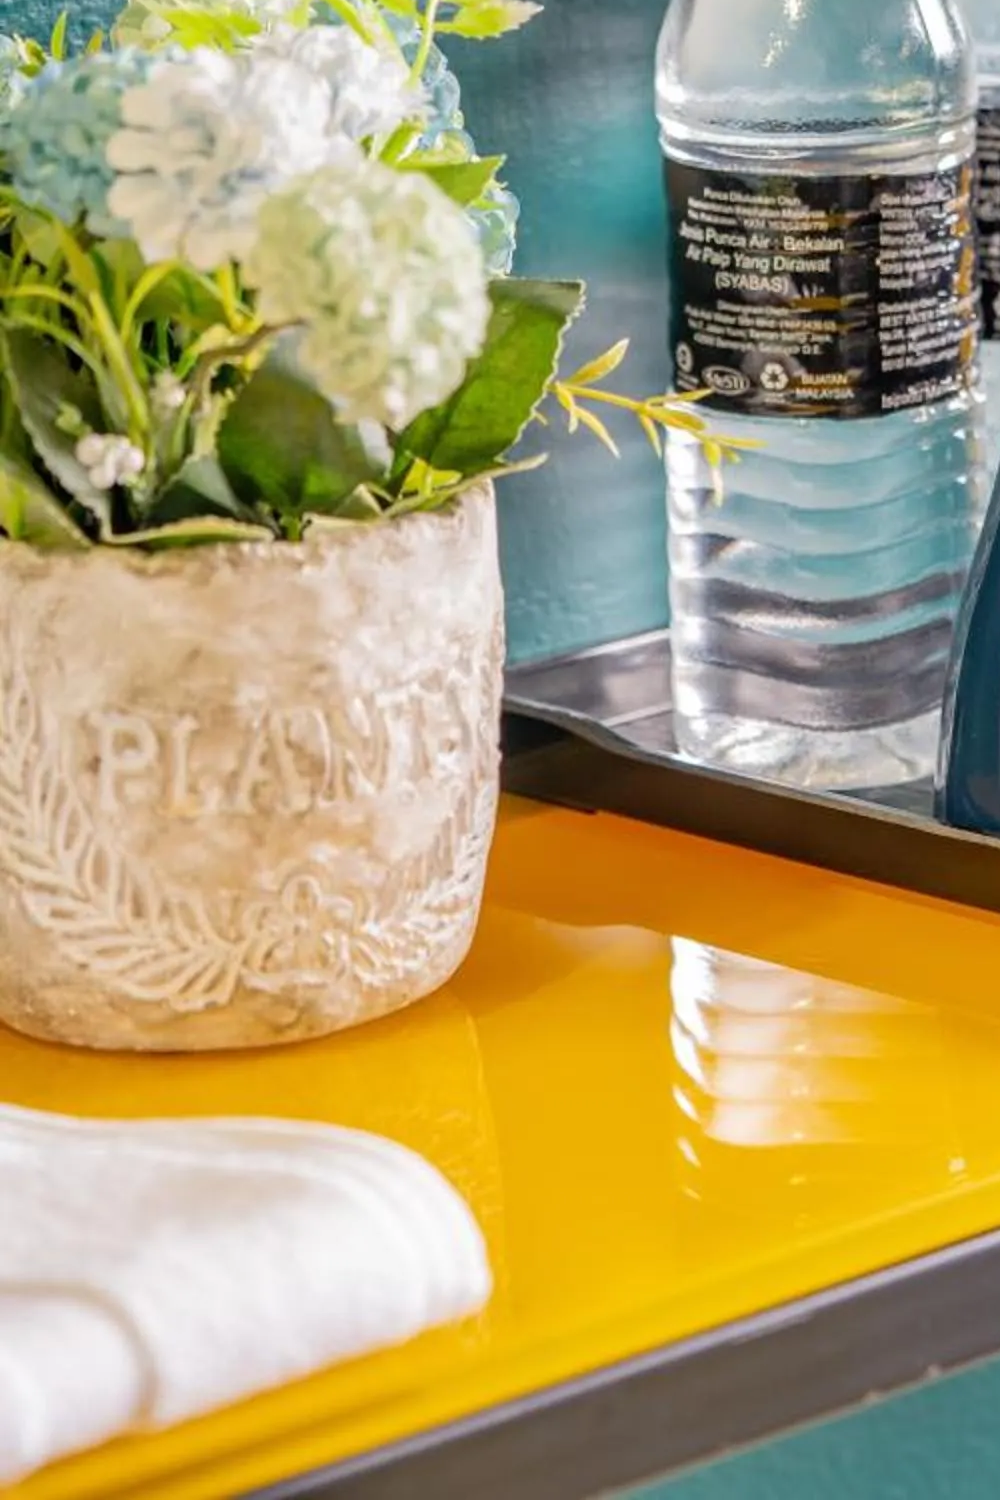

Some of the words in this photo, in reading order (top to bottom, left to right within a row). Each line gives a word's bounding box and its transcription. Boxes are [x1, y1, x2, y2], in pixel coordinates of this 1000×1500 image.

[705, 226, 747, 248] Punca
[749, 233, 770, 250] Air
[783, 234, 845, 252] Bekalan
[702, 246, 731, 269] Paip
[733, 252, 769, 274] Yang
[773, 255, 832, 273] Dirawat
[714, 271, 790, 295] (SYABAS)
[795, 386, 855, 401] MALAYSIA
